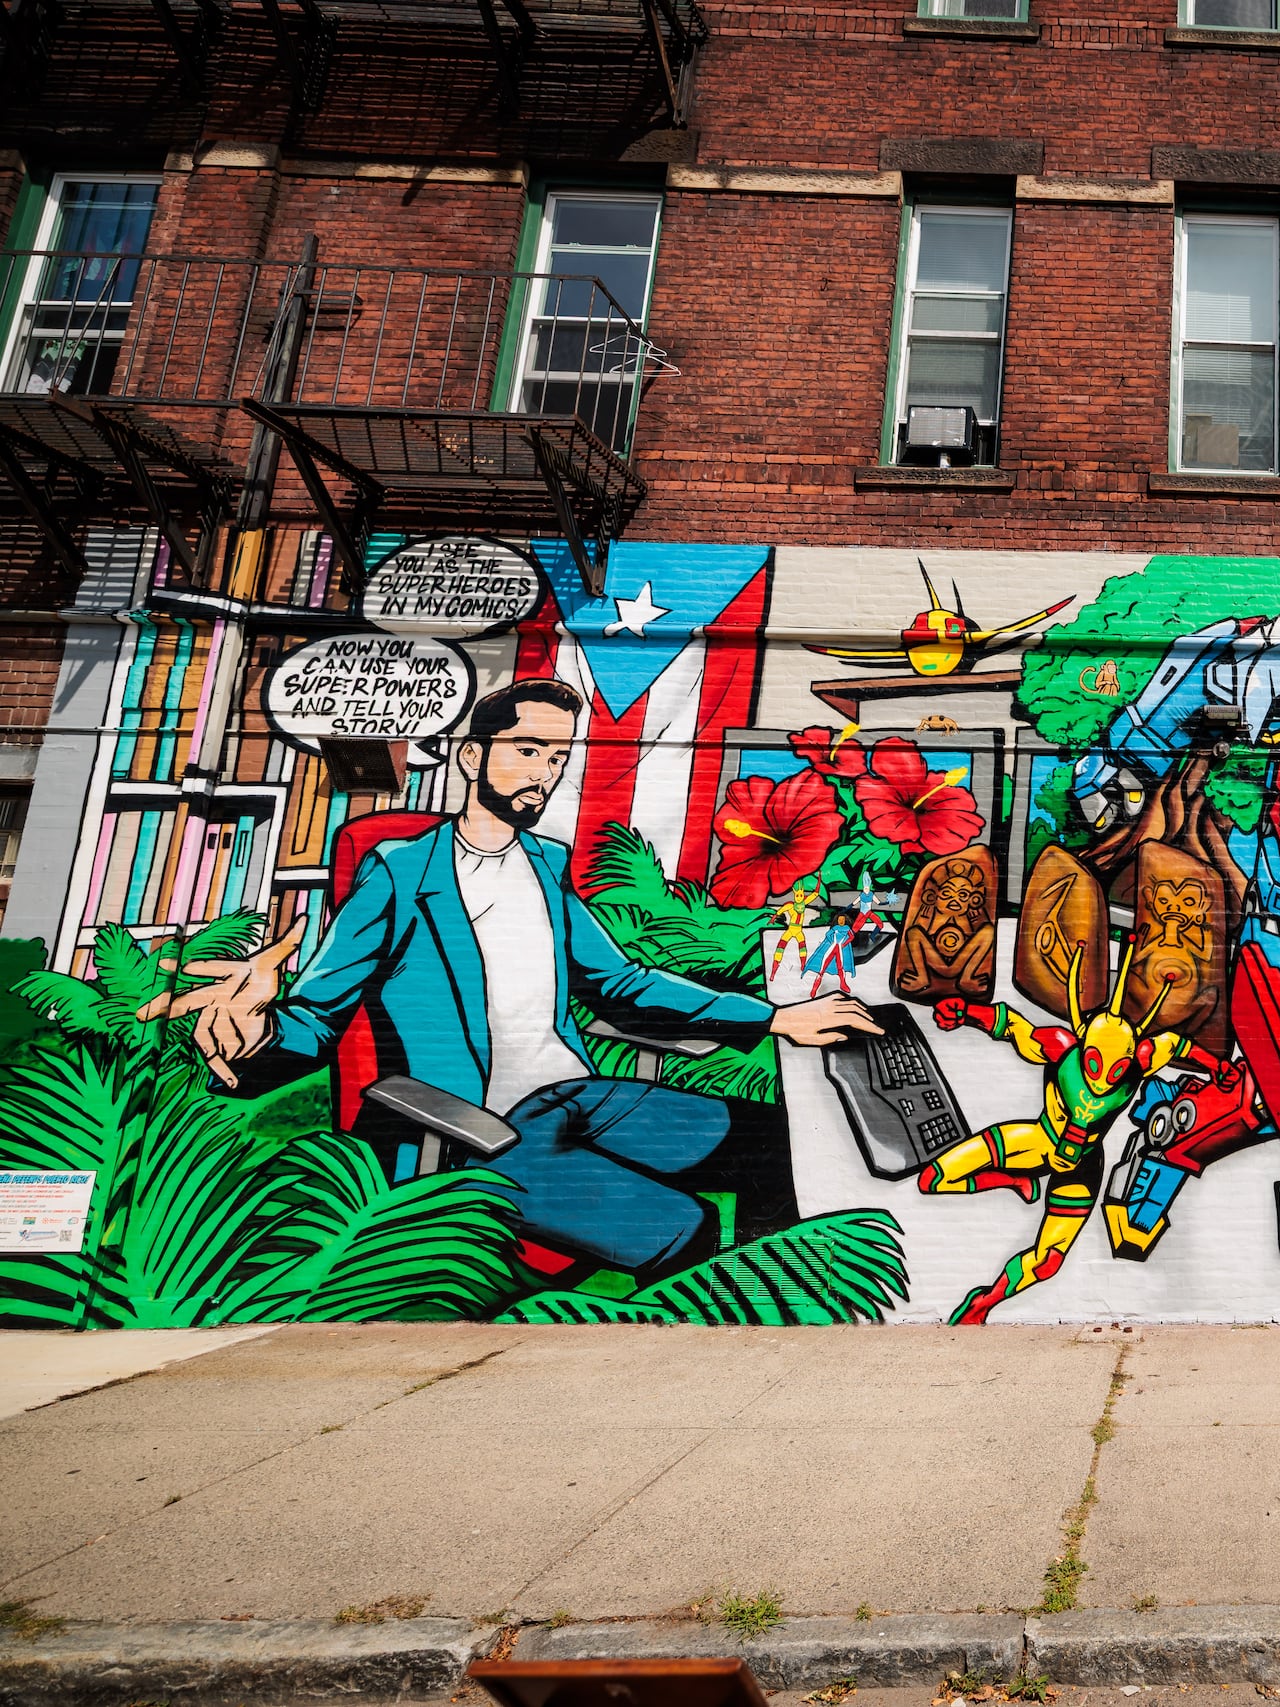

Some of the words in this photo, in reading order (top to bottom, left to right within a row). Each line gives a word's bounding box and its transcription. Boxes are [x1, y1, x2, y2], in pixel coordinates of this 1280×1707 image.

[427, 543, 435, 558] I
[440, 543, 481, 559] SEE
[394, 556, 425, 574] YOU
[432, 559, 460, 574] AS
[467, 559, 503, 575] THE
[380, 595, 408, 615] IN
[413, 595, 446, 617] MY
[445, 596, 529, 620] COMICS!
[325, 639, 374, 657] NOW
[377, 640, 415, 659] YOU
[302, 656, 356, 675] CAN
[359, 657, 398, 675] USE
[405, 657, 453, 676] YOUR
[291, 697, 337, 718] AND
[342, 699, 394, 717] TELL
[399, 698, 444, 719] YOUR
[331, 718, 420, 736] STORY!
